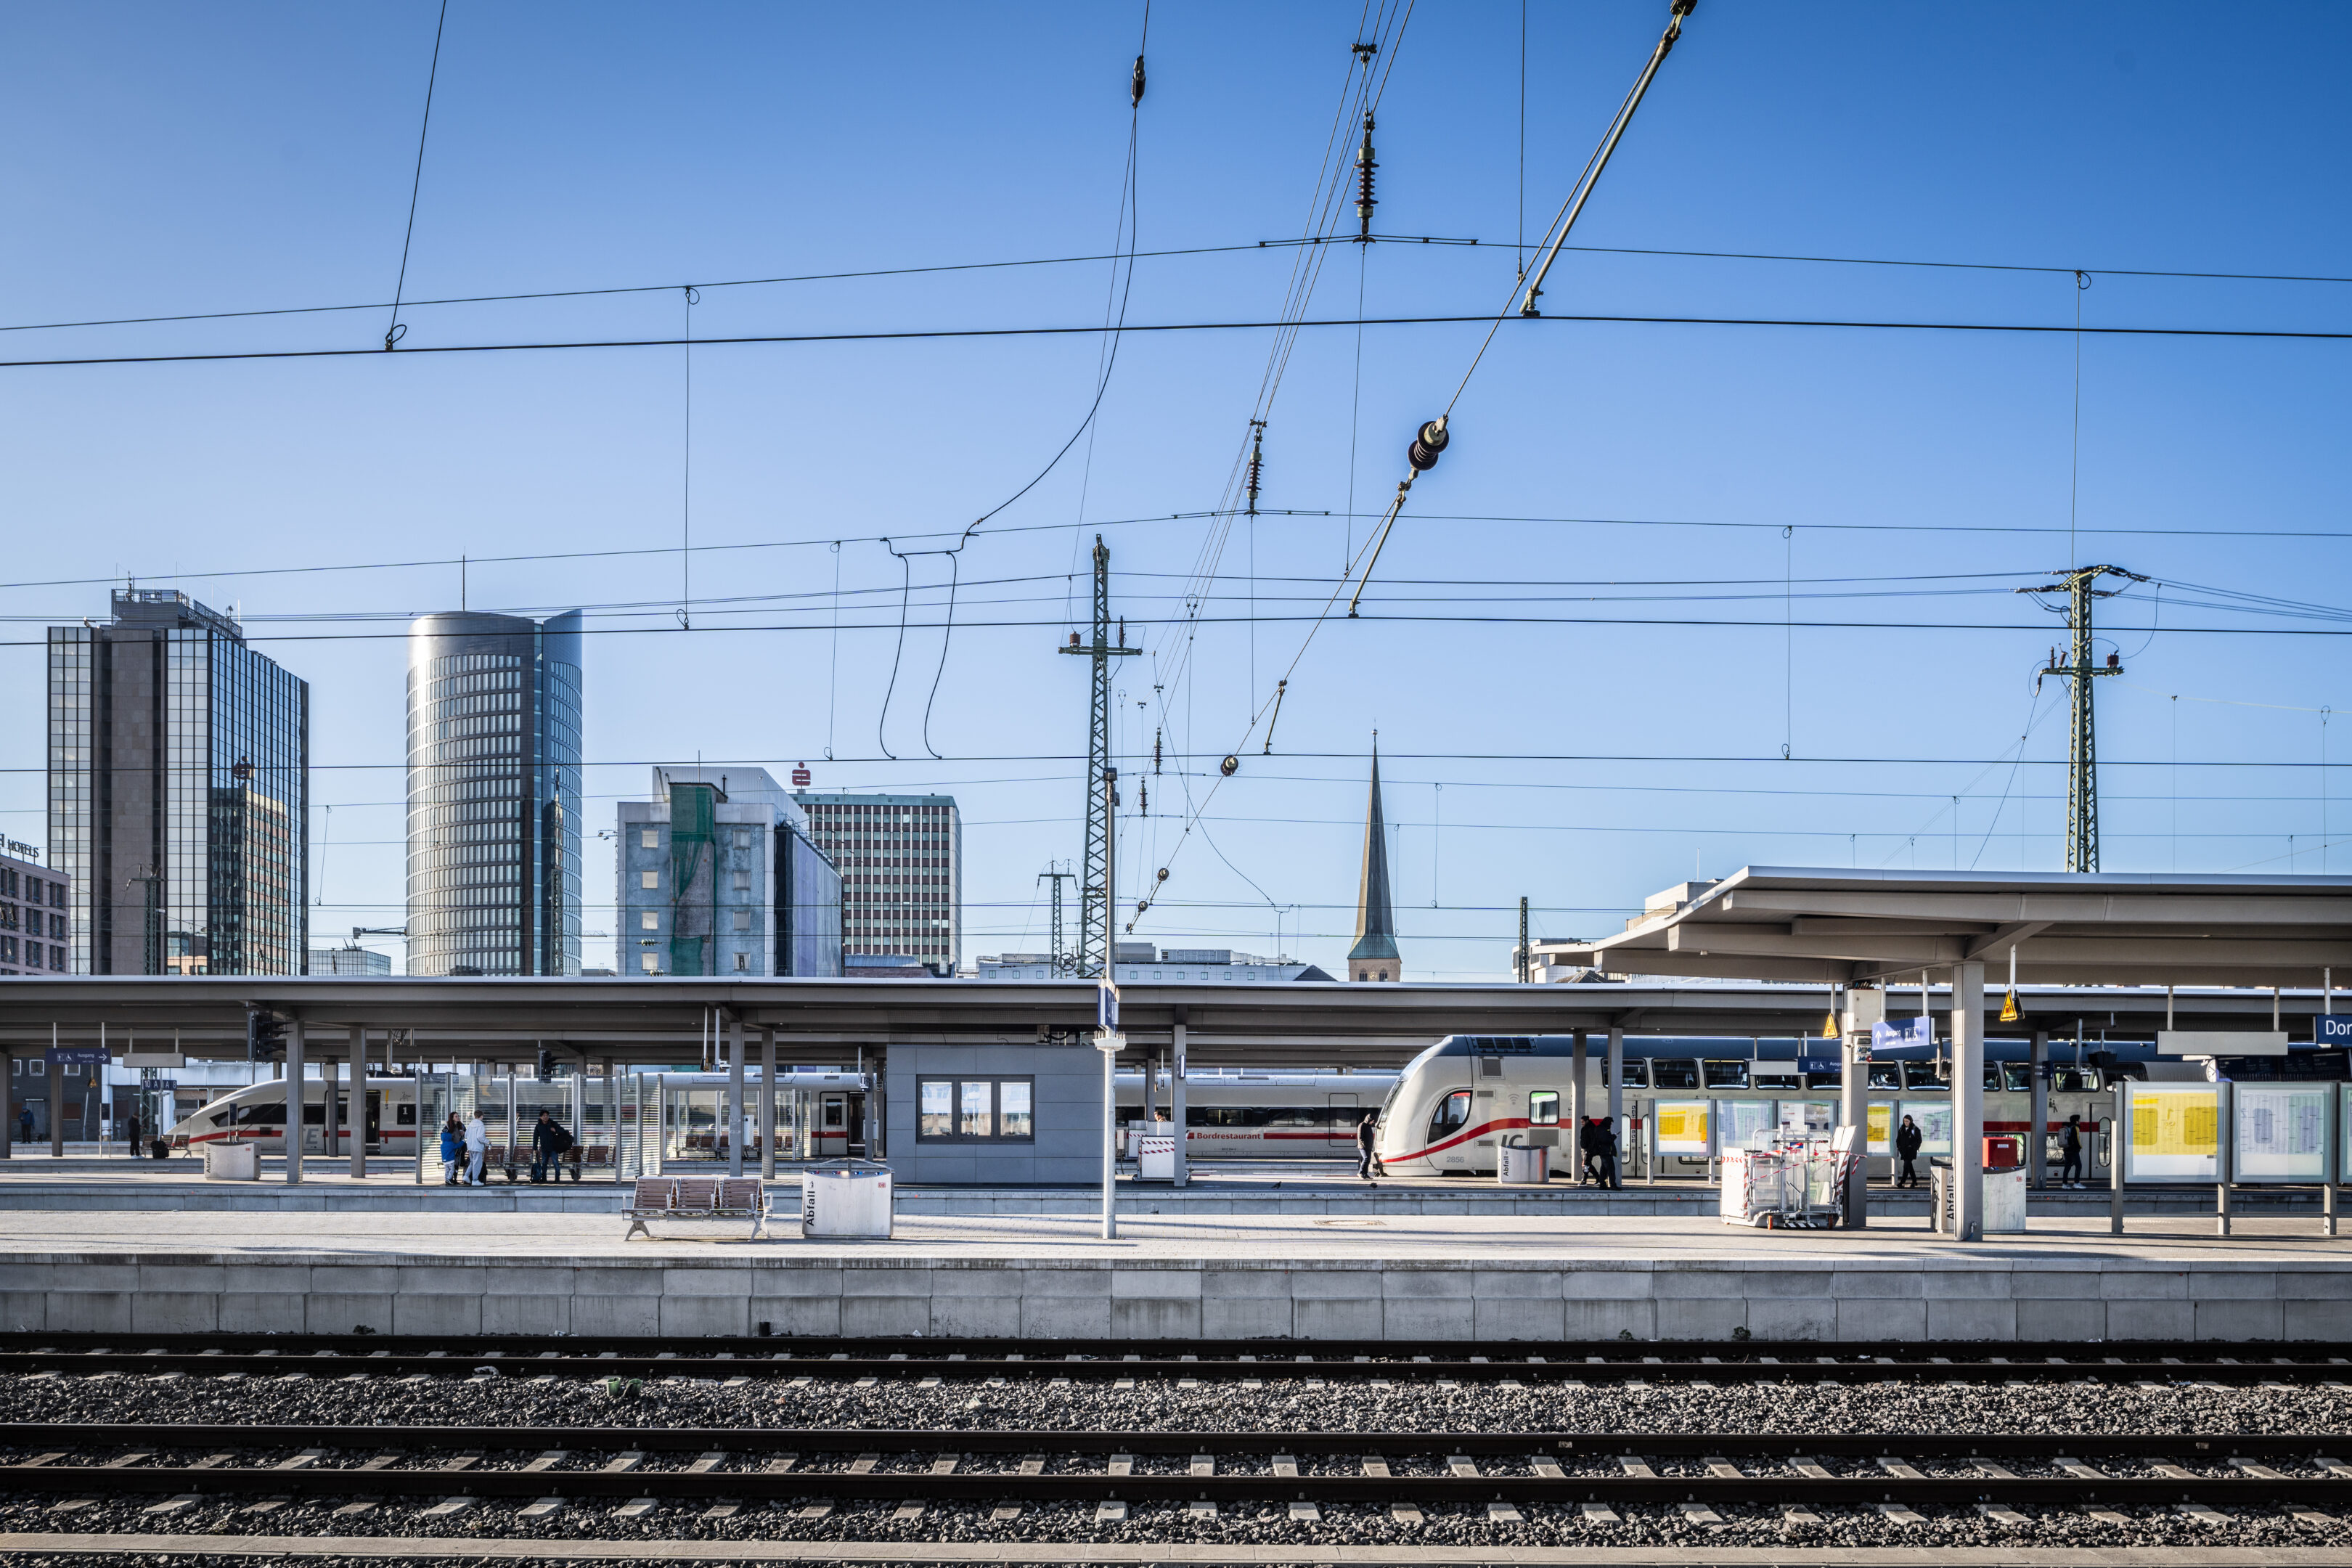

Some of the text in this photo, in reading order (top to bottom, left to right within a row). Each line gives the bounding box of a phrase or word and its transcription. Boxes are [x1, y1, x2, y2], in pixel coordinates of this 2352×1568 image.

[8, 839, 39, 857] HOTELS
[2326, 1020, 2352, 1035] Dor
[807, 1191, 815, 1226] Abfall
